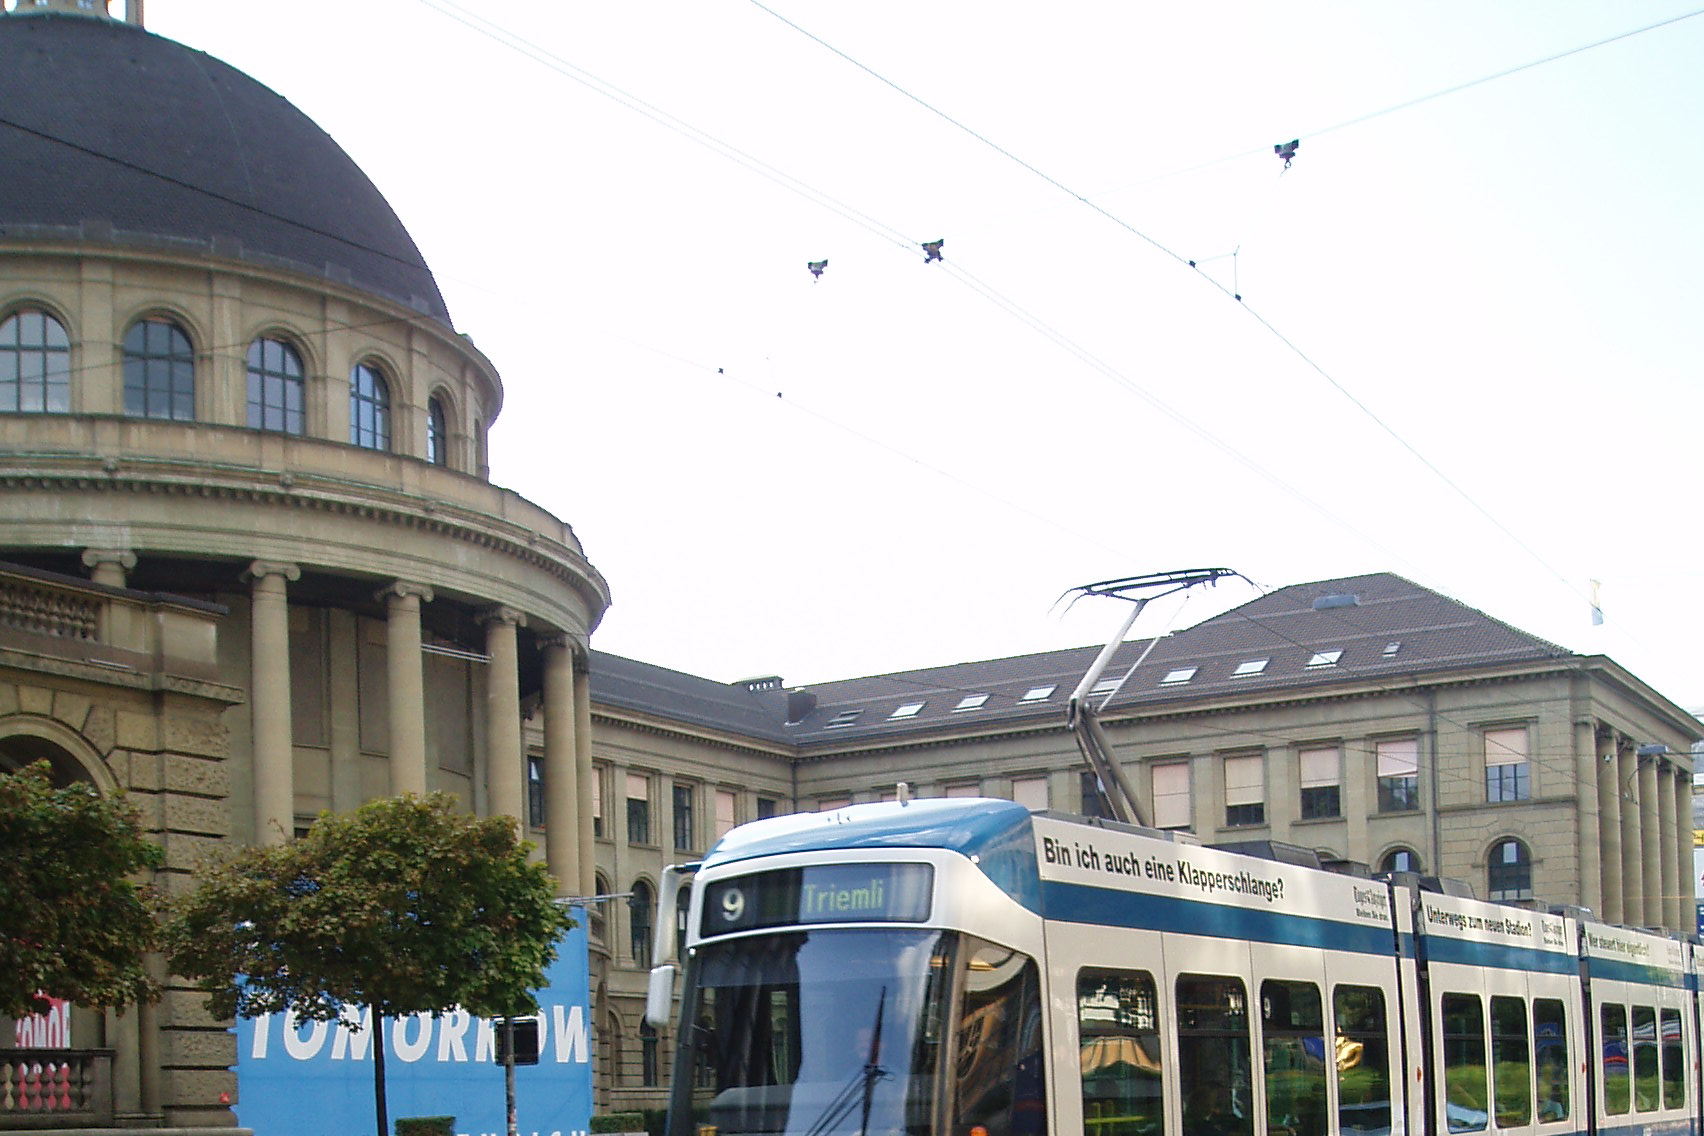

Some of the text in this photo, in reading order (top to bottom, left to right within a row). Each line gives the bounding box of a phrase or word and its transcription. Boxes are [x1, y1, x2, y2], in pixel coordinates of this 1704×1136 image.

[1043, 836, 1285, 903] Bin ich auch eine Klapperschlange?
[723, 888, 745, 922] 9
[803, 879, 884, 914] Triemli
[1426, 904, 1467, 931] Unterwegs
[1468, 916, 1484, 931] zum
[1484, 918, 1505, 934] neuen
[248, 999, 588, 1063] TOMORW
